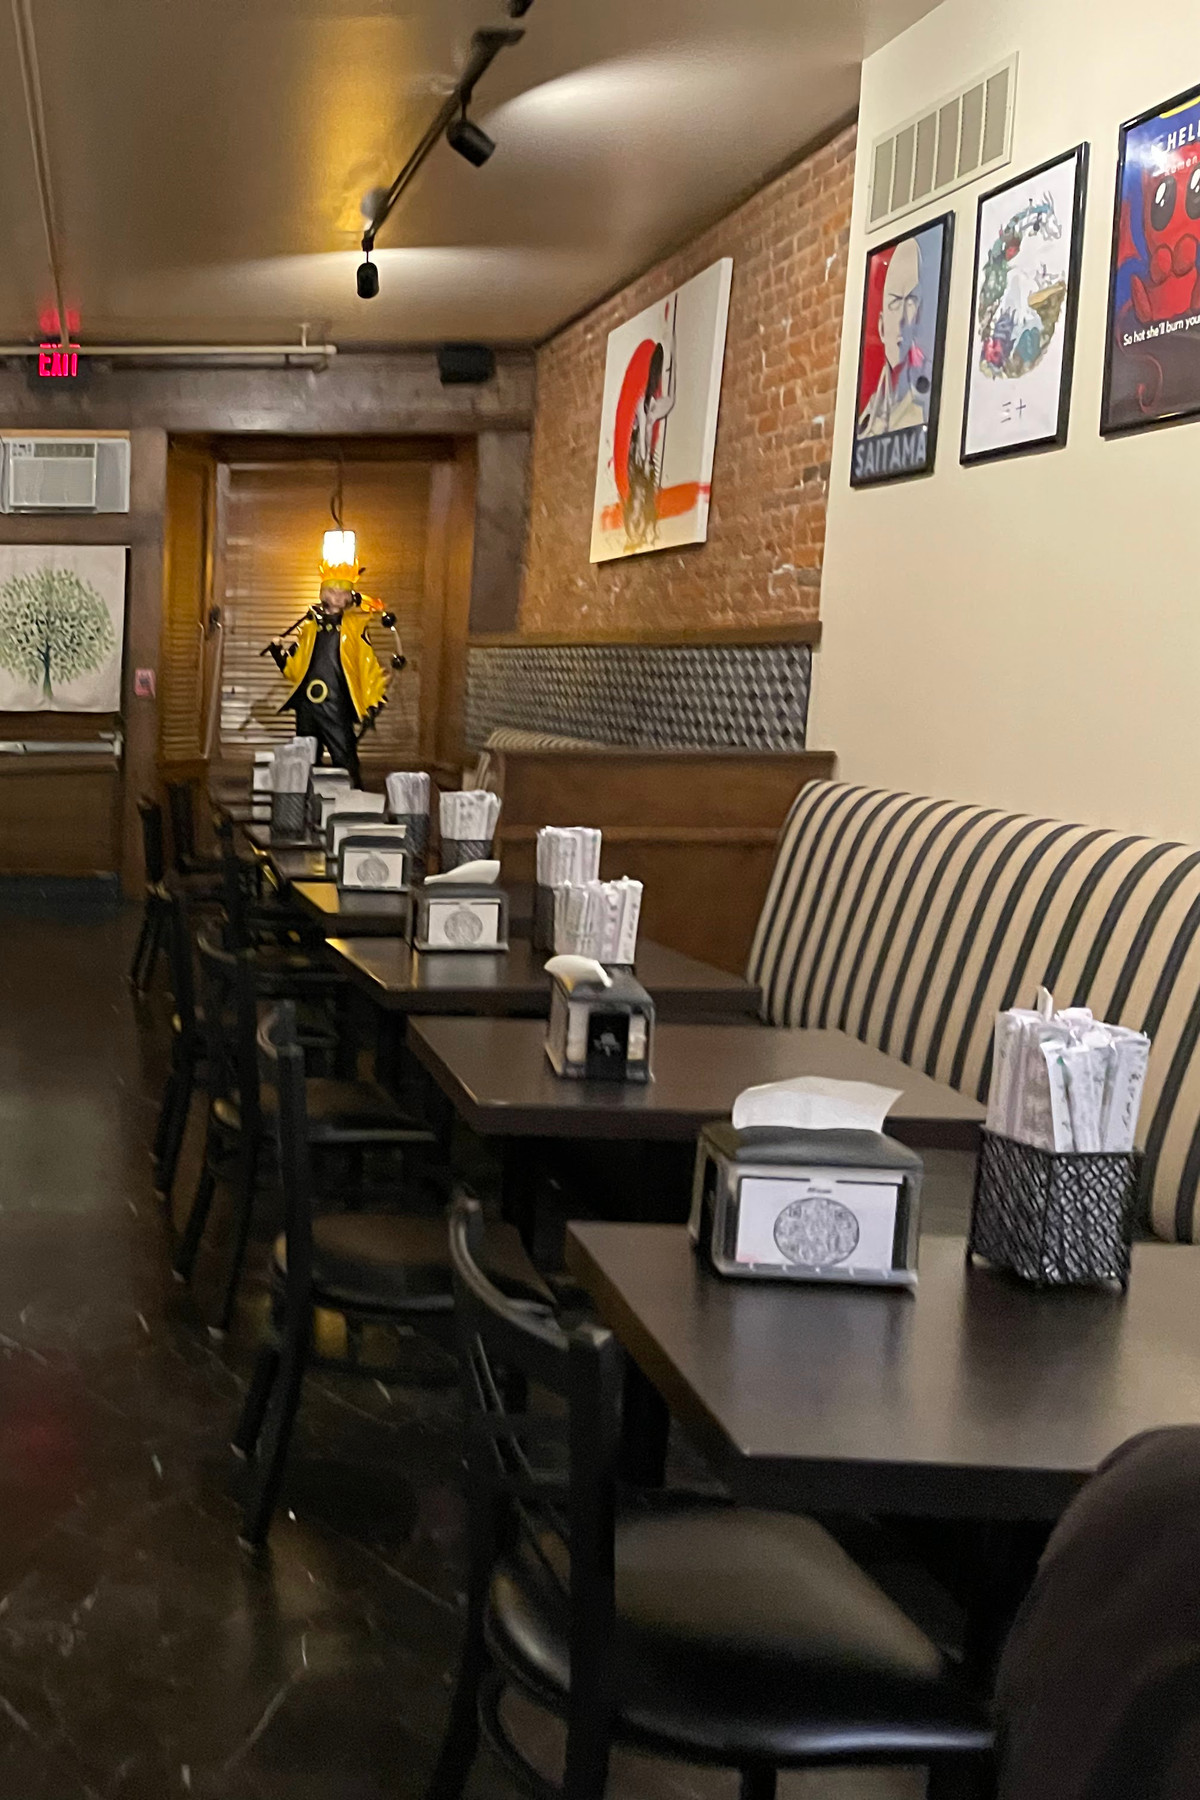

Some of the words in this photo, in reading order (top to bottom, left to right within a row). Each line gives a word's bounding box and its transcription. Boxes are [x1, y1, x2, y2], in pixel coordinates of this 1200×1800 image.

[1123, 333, 1133, 346] So
[1133, 330, 1145, 343] hot
[1146, 321, 1166, 339] she'll
[1166, 320, 1184, 333] burn
[38, 343, 81, 377] EXIT
[855, 430, 927, 478] SAITAMA
